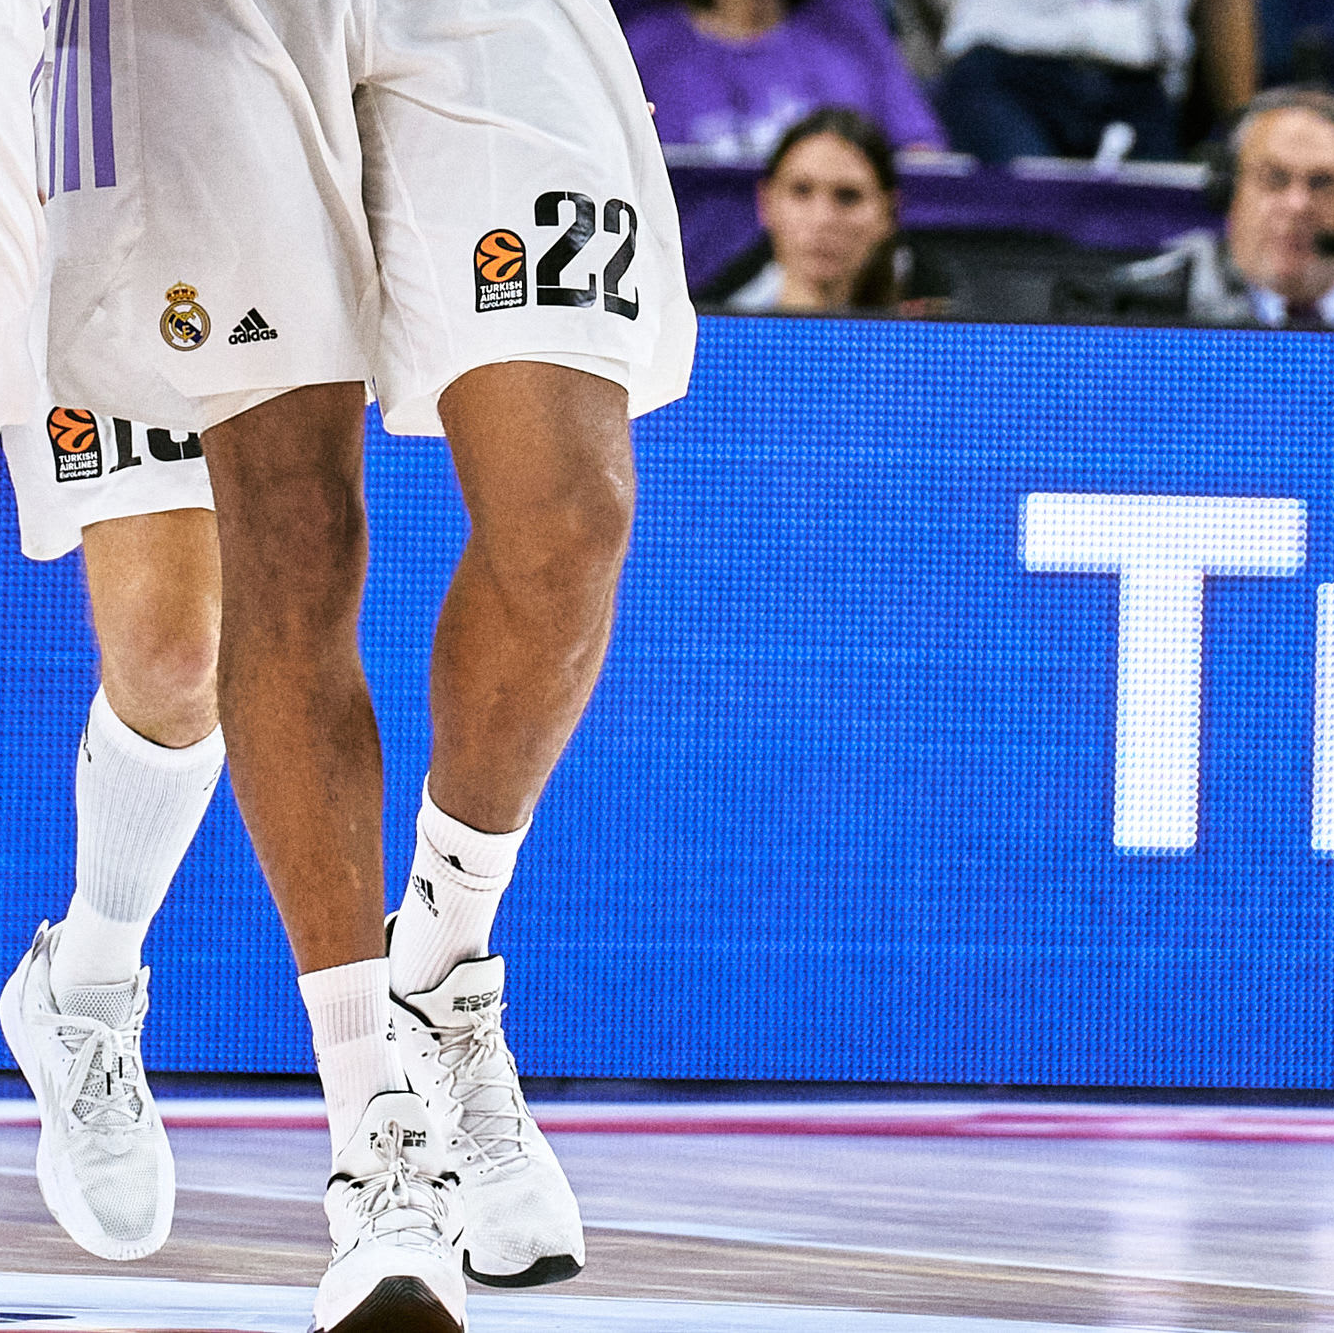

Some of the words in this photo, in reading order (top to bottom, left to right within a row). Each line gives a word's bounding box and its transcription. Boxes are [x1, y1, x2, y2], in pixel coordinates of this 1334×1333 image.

[534, 190, 640, 322] 22
[479, 280, 523, 294] TURKISH
[479, 290, 523, 303] AIRLINES
[228, 327, 279, 345] adidas
[58, 451, 98, 463] TURKISH
[58, 460, 99, 472] AIRLINES
